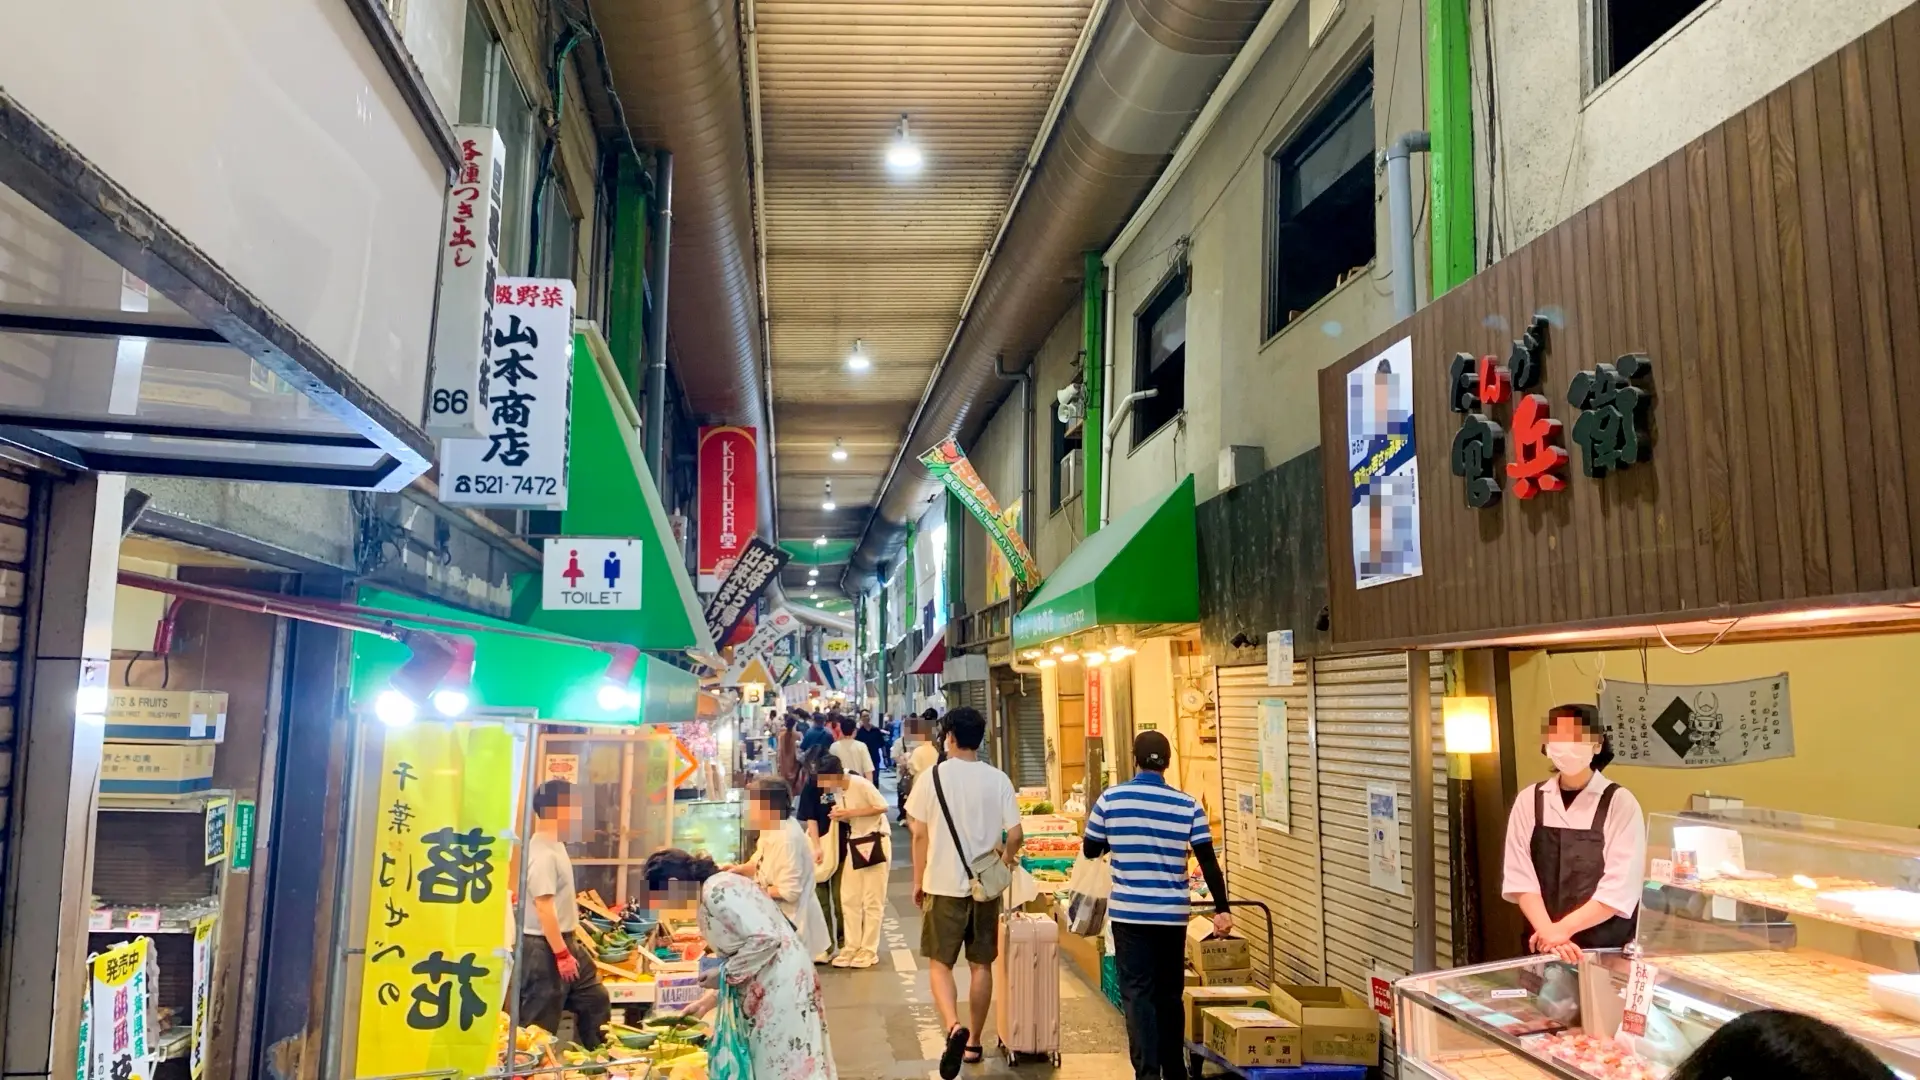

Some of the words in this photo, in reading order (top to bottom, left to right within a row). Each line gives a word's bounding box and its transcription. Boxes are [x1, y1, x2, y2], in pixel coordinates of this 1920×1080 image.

[495, 283, 564, 308] 級野菜
[432, 388, 469, 414] 66
[481, 314, 538, 467] 山本商店
[1451, 352, 1652, 508] 官兵衛
[561, 591, 622, 604] TOILET
[110, 696, 126, 708] UTS
[129, 697, 136, 708] &
[138, 697, 168, 708] FRUITS
[106, 951, 139, 984] 発売中
